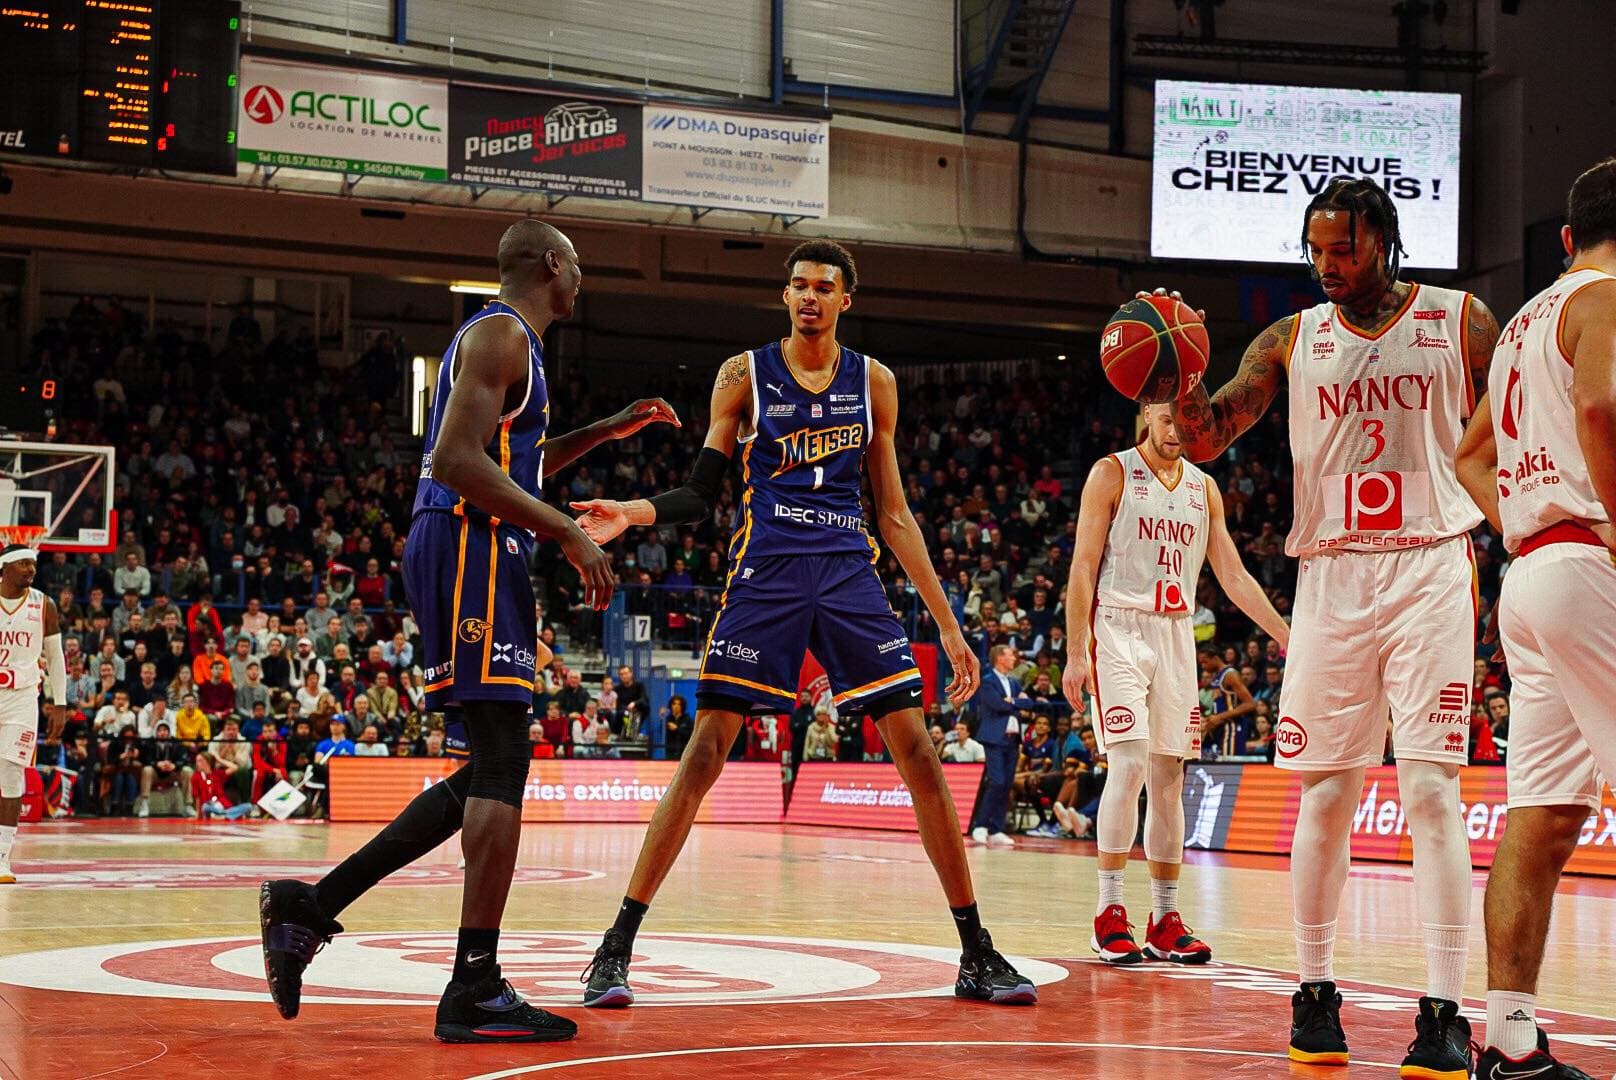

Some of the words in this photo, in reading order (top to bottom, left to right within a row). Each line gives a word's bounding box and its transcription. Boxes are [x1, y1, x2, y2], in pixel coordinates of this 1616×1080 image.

[291, 90, 442, 132] ACTILOC
[289, 121, 355, 135] LOCATION
[361, 128, 376, 138] DE
[545, 116, 618, 146] Autos
[677, 116, 720, 134] DMA
[723, 122, 825, 145] Dupasquier
[652, 140, 678, 150] PONT
[740, 149, 763, 160] METZ
[771, 152, 821, 165] THIONVILLE
[1206, 150, 1402, 176] BIENVENUE
[648, 185, 701, 198] Transporteur
[702, 190, 731, 201] Officiel
[733, 193, 744, 202] du
[746, 194, 769, 205] SLUC
[1172, 167, 1288, 194] CHEZ
[1432, 179, 1441, 200] !
[1313, 341, 1335, 349] CRÉA
[42, 380, 56, 399] 8
[1317, 374, 1434, 420] NANCY
[774, 424, 863, 470] METS92
[1361, 419, 1386, 465] 3
[813, 465, 824, 491] 1
[774, 504, 815, 524] IDEC
[1138, 516, 1198, 547] NANCY
[1157, 545, 1183, 577] 40
[0, 631, 33, 648] NCY
[638, 619, 648, 638] 7
[727, 641, 760, 661] idex
[1106, 712, 1133, 727] cora
[1277, 728, 1303, 746] cora
